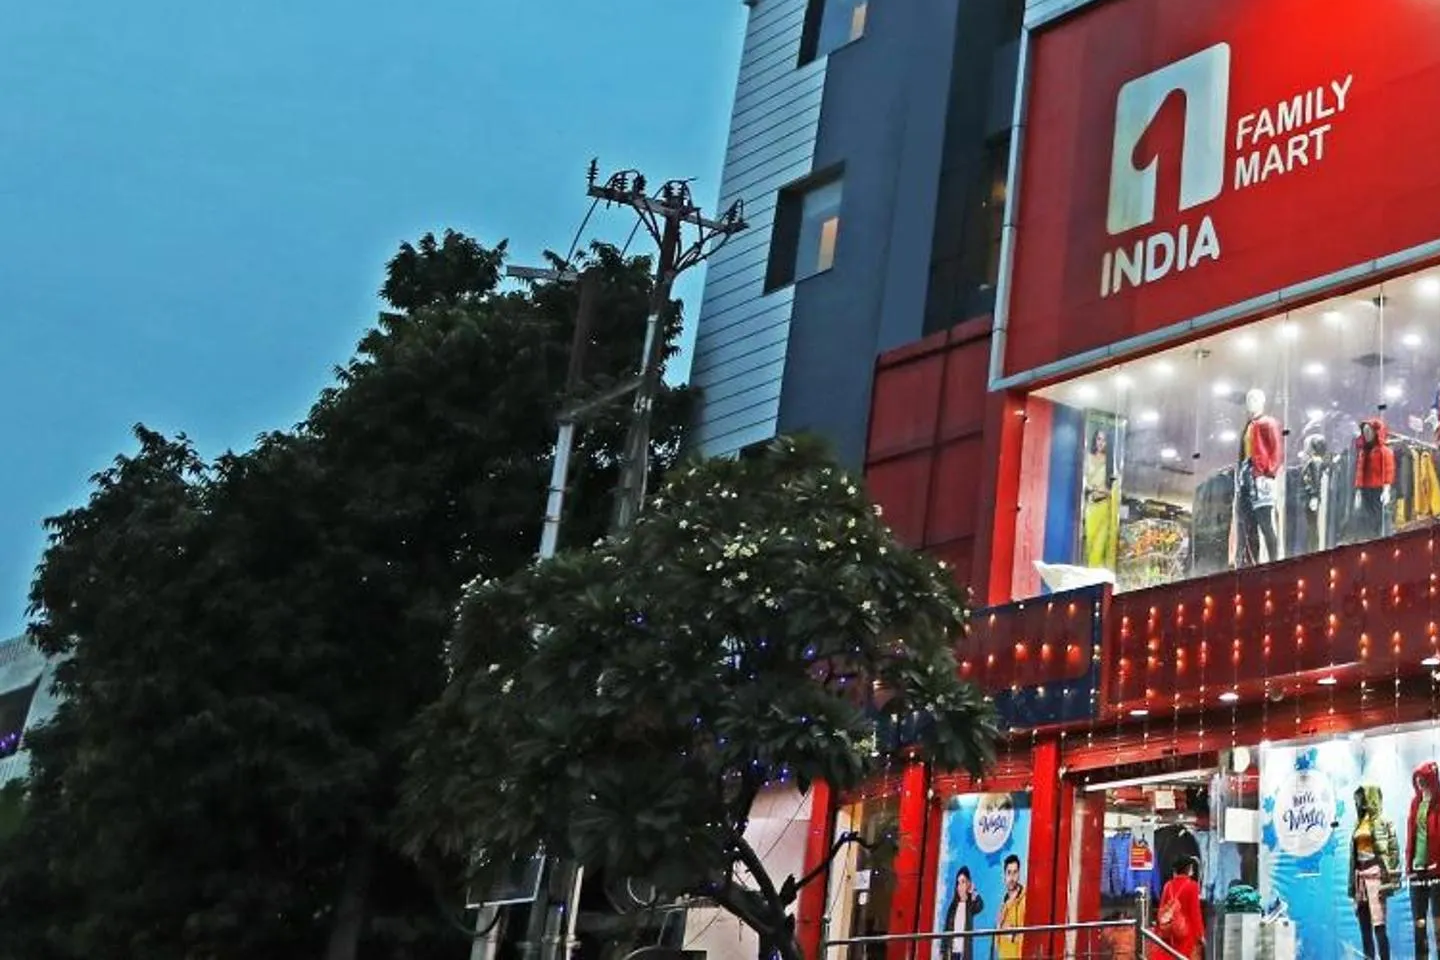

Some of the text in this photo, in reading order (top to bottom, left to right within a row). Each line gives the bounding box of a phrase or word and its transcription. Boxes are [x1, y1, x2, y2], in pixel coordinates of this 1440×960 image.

[1236, 74, 1354, 150] FAMILY
[1234, 125, 1331, 190] MART
[1100, 215, 1221, 298] INDIA
